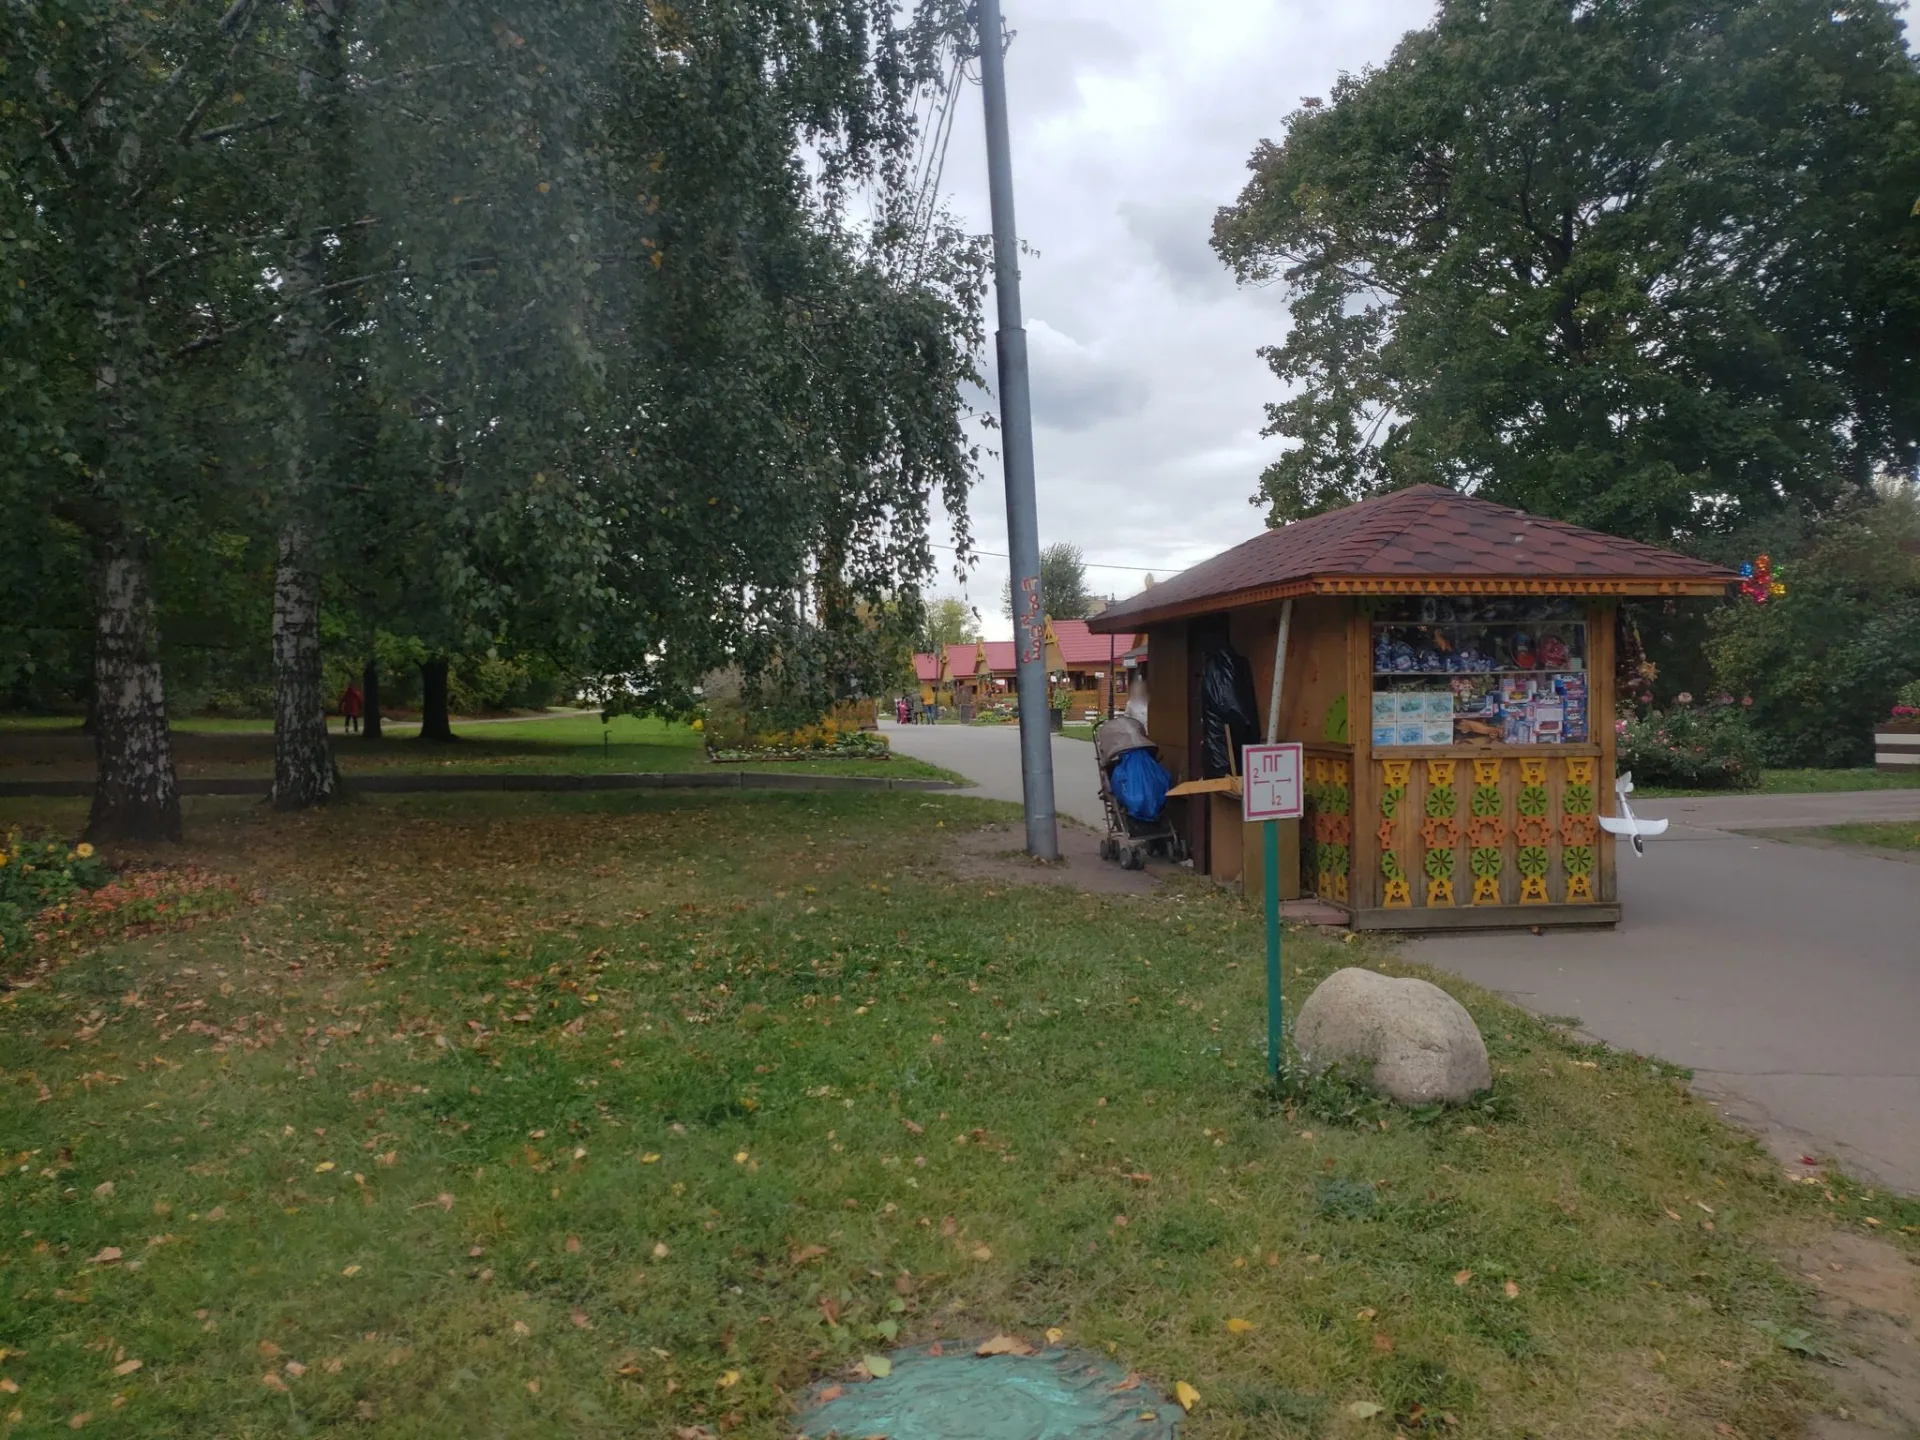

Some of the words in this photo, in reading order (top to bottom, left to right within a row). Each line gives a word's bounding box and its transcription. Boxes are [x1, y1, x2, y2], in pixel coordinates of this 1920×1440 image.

[1263, 754, 1283, 773] ПГ
[1253, 767, 1260, 779] 2
[1275, 795, 1282, 806] 2
